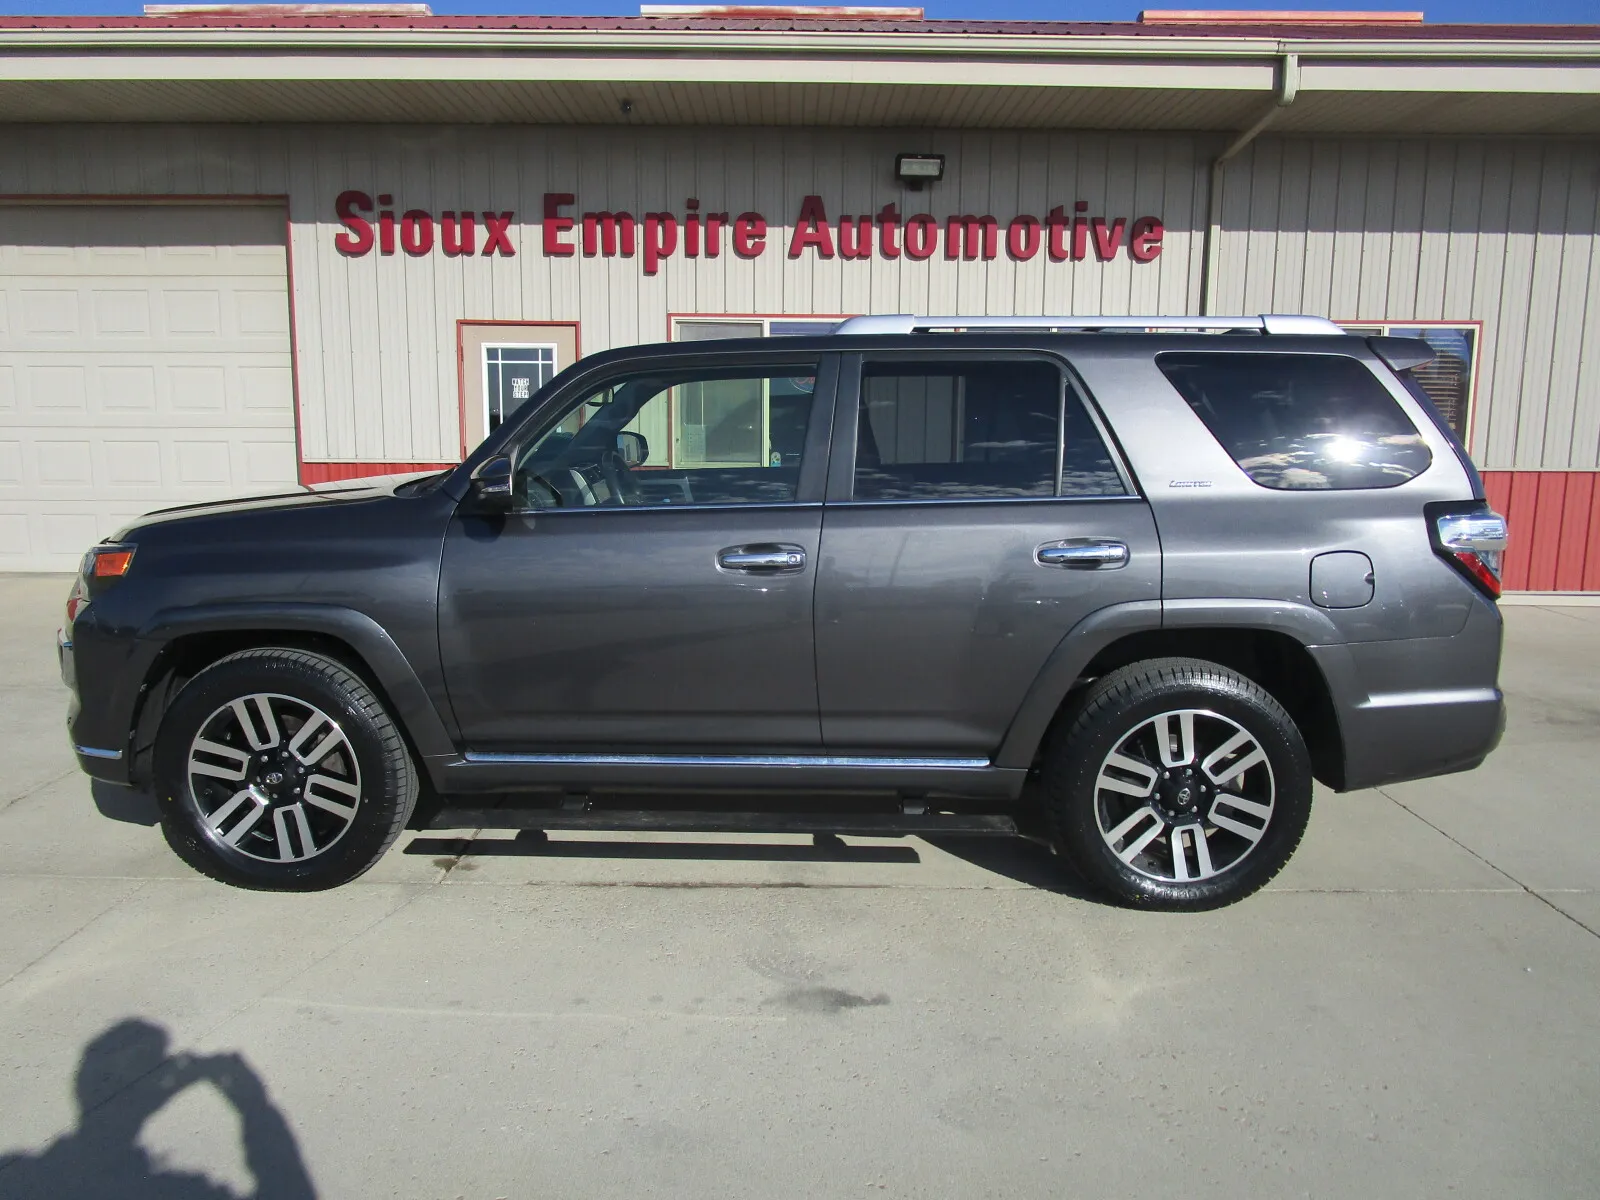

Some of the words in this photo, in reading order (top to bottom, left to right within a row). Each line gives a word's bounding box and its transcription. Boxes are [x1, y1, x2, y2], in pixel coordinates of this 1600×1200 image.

[335, 190, 516, 257] Sioux
[542, 192, 767, 276] Empire
[787, 194, 1164, 263] Automotive
